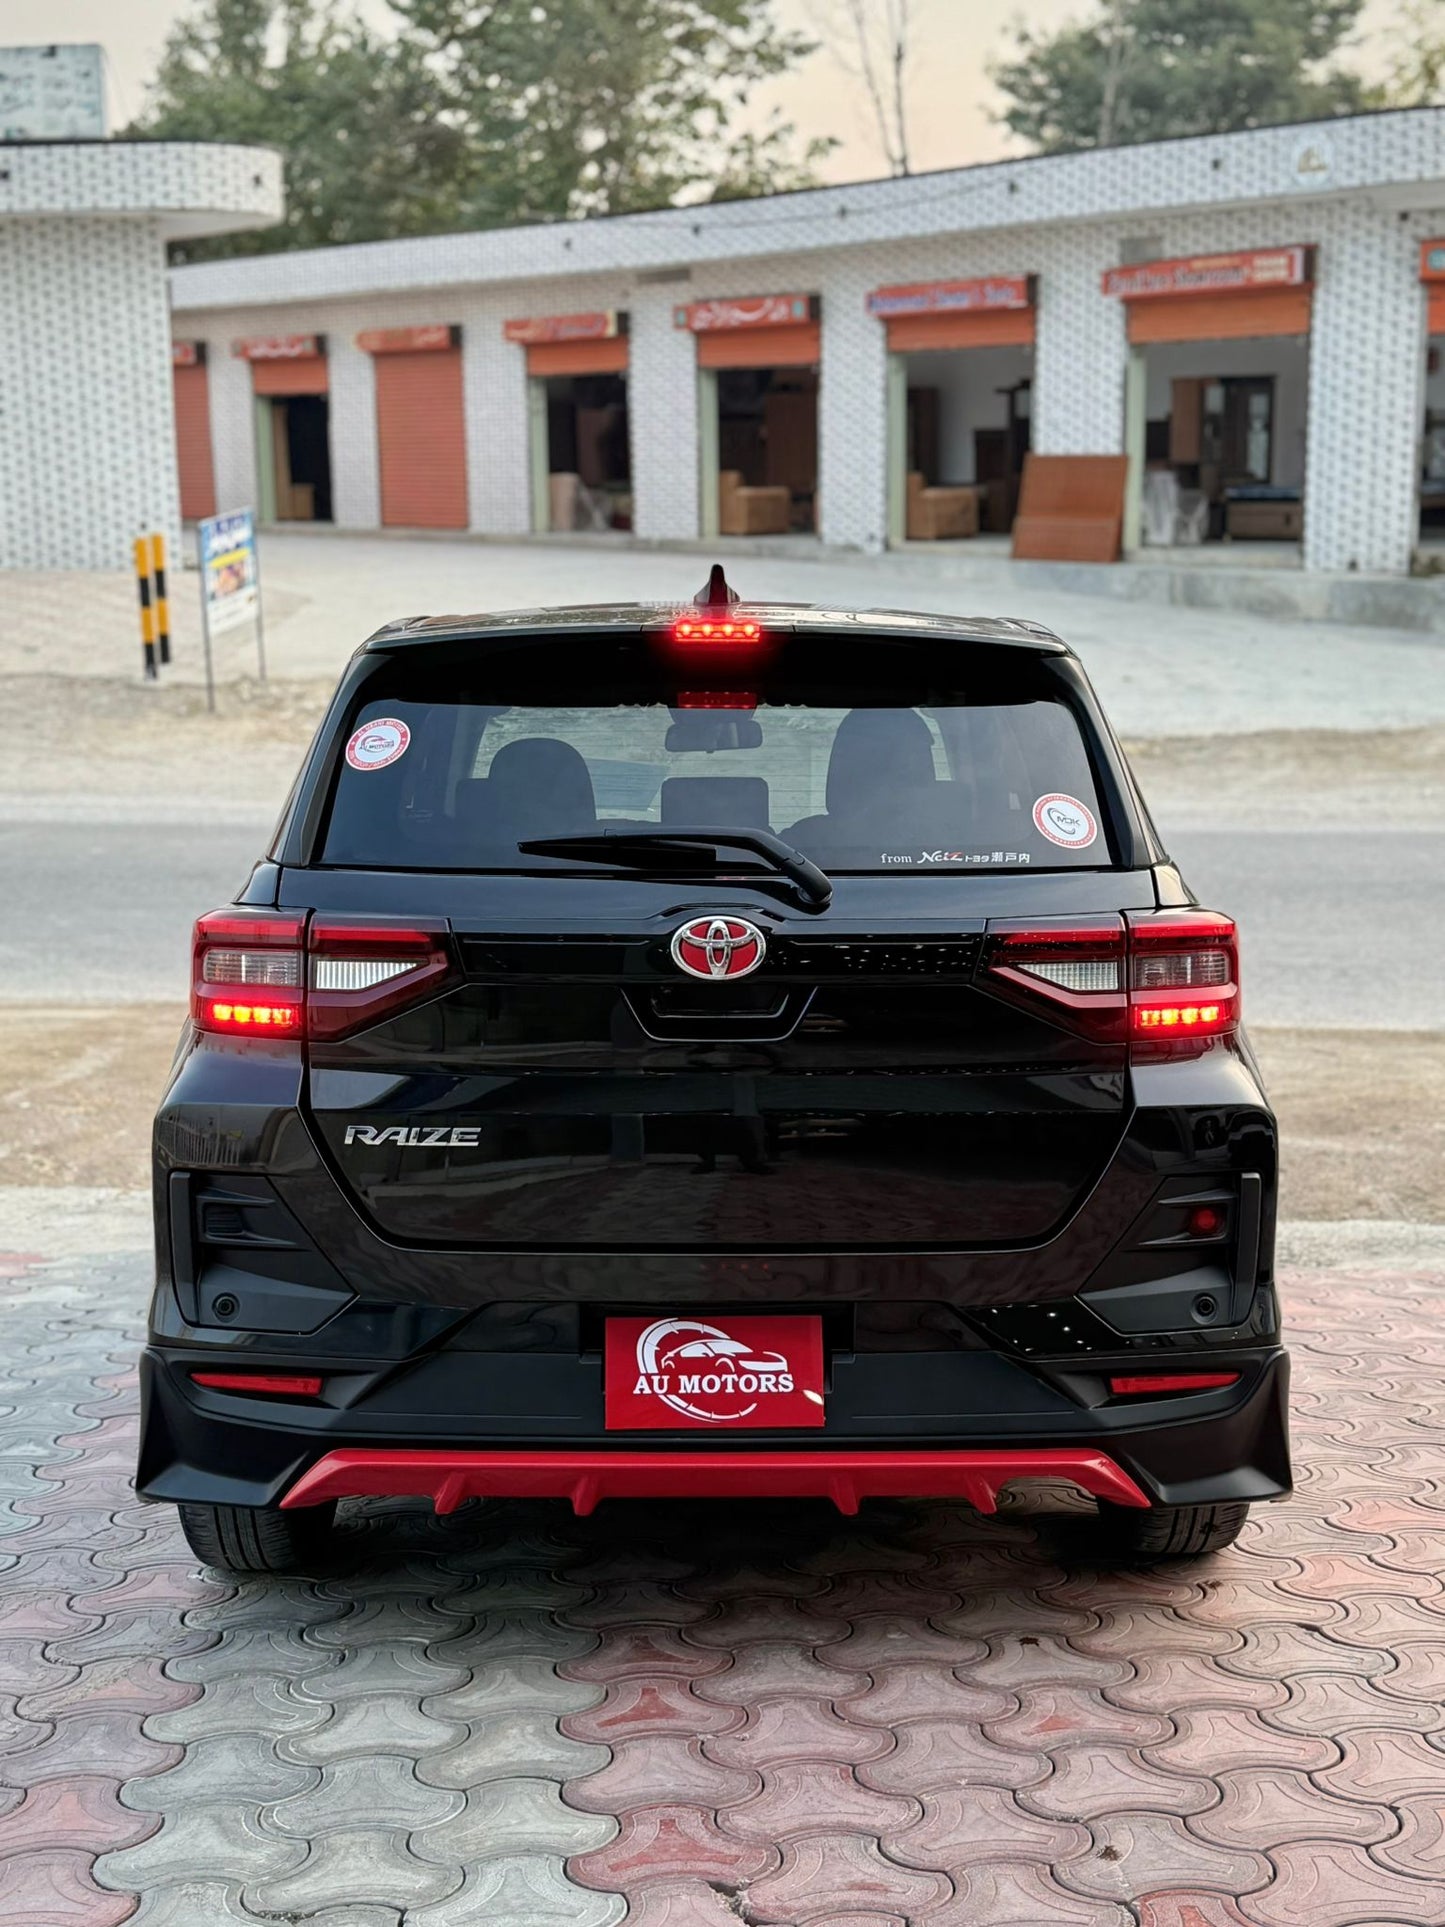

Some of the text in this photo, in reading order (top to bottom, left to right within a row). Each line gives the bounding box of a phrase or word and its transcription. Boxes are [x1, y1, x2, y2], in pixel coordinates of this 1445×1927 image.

[880, 853, 912, 864] from
[344, 1125, 482, 1147] RAIZE
[633, 1373, 794, 1394] AU MOTORS
